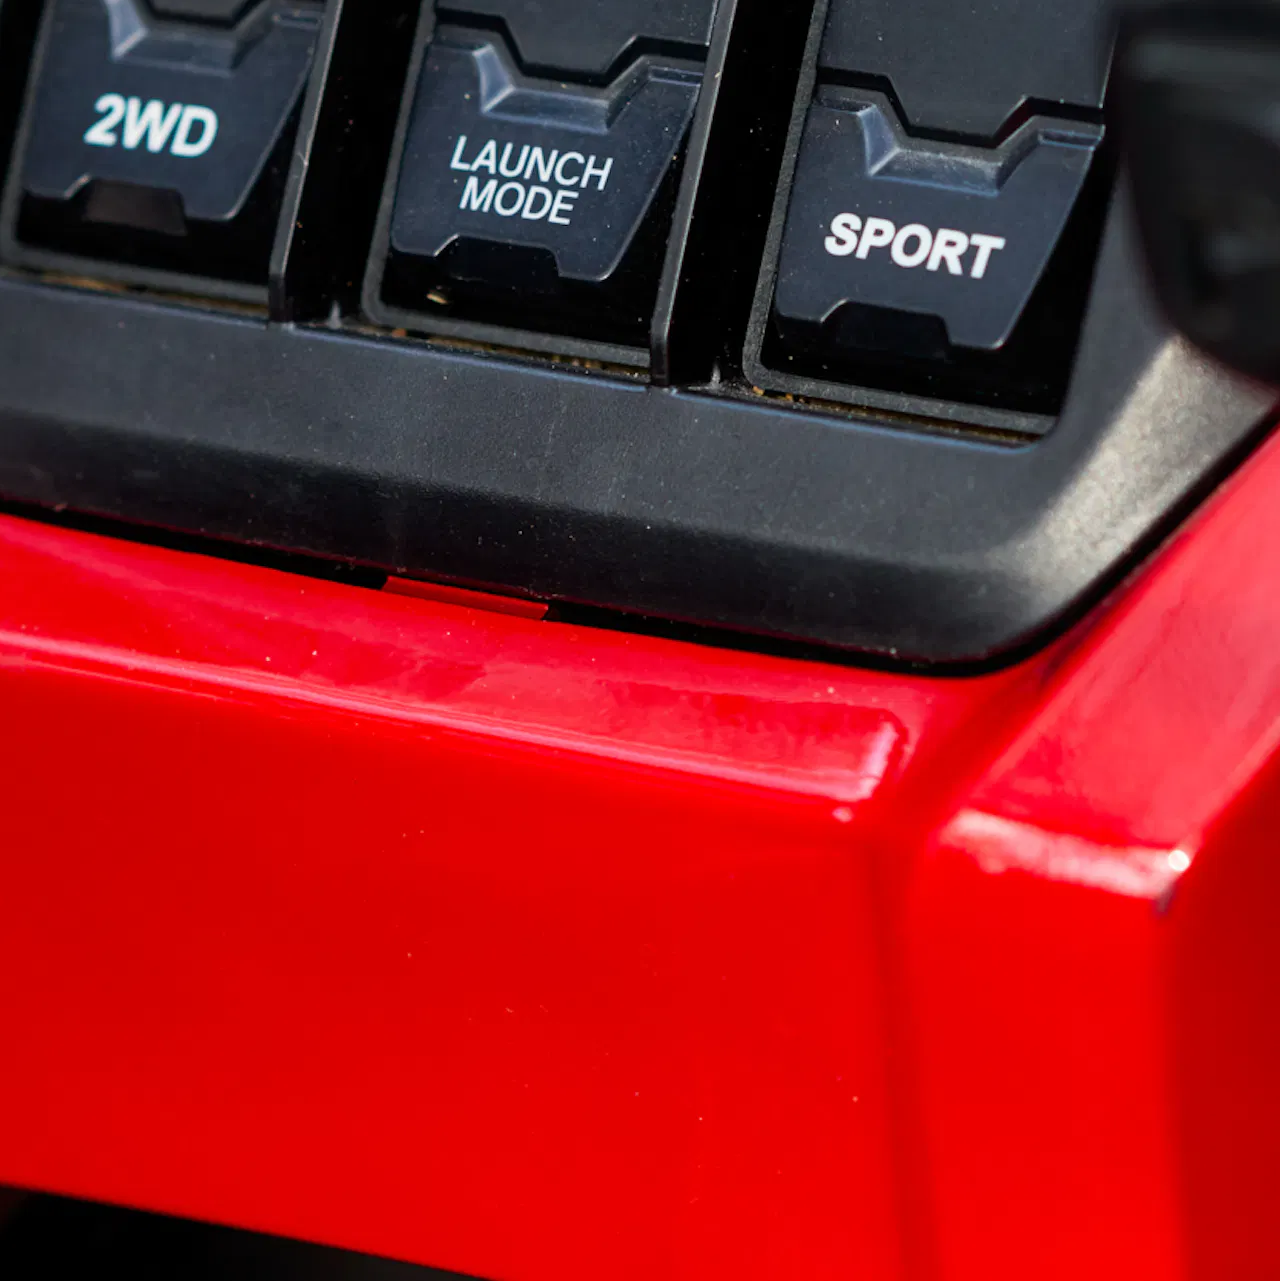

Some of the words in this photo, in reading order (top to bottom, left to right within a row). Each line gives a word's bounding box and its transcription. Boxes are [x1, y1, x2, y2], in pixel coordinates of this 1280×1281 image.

[83, 92, 219, 158] 2WD
[449, 134, 615, 192] LAUNCH
[458, 174, 580, 226] MODE
[823, 211, 1007, 280] SPORT
